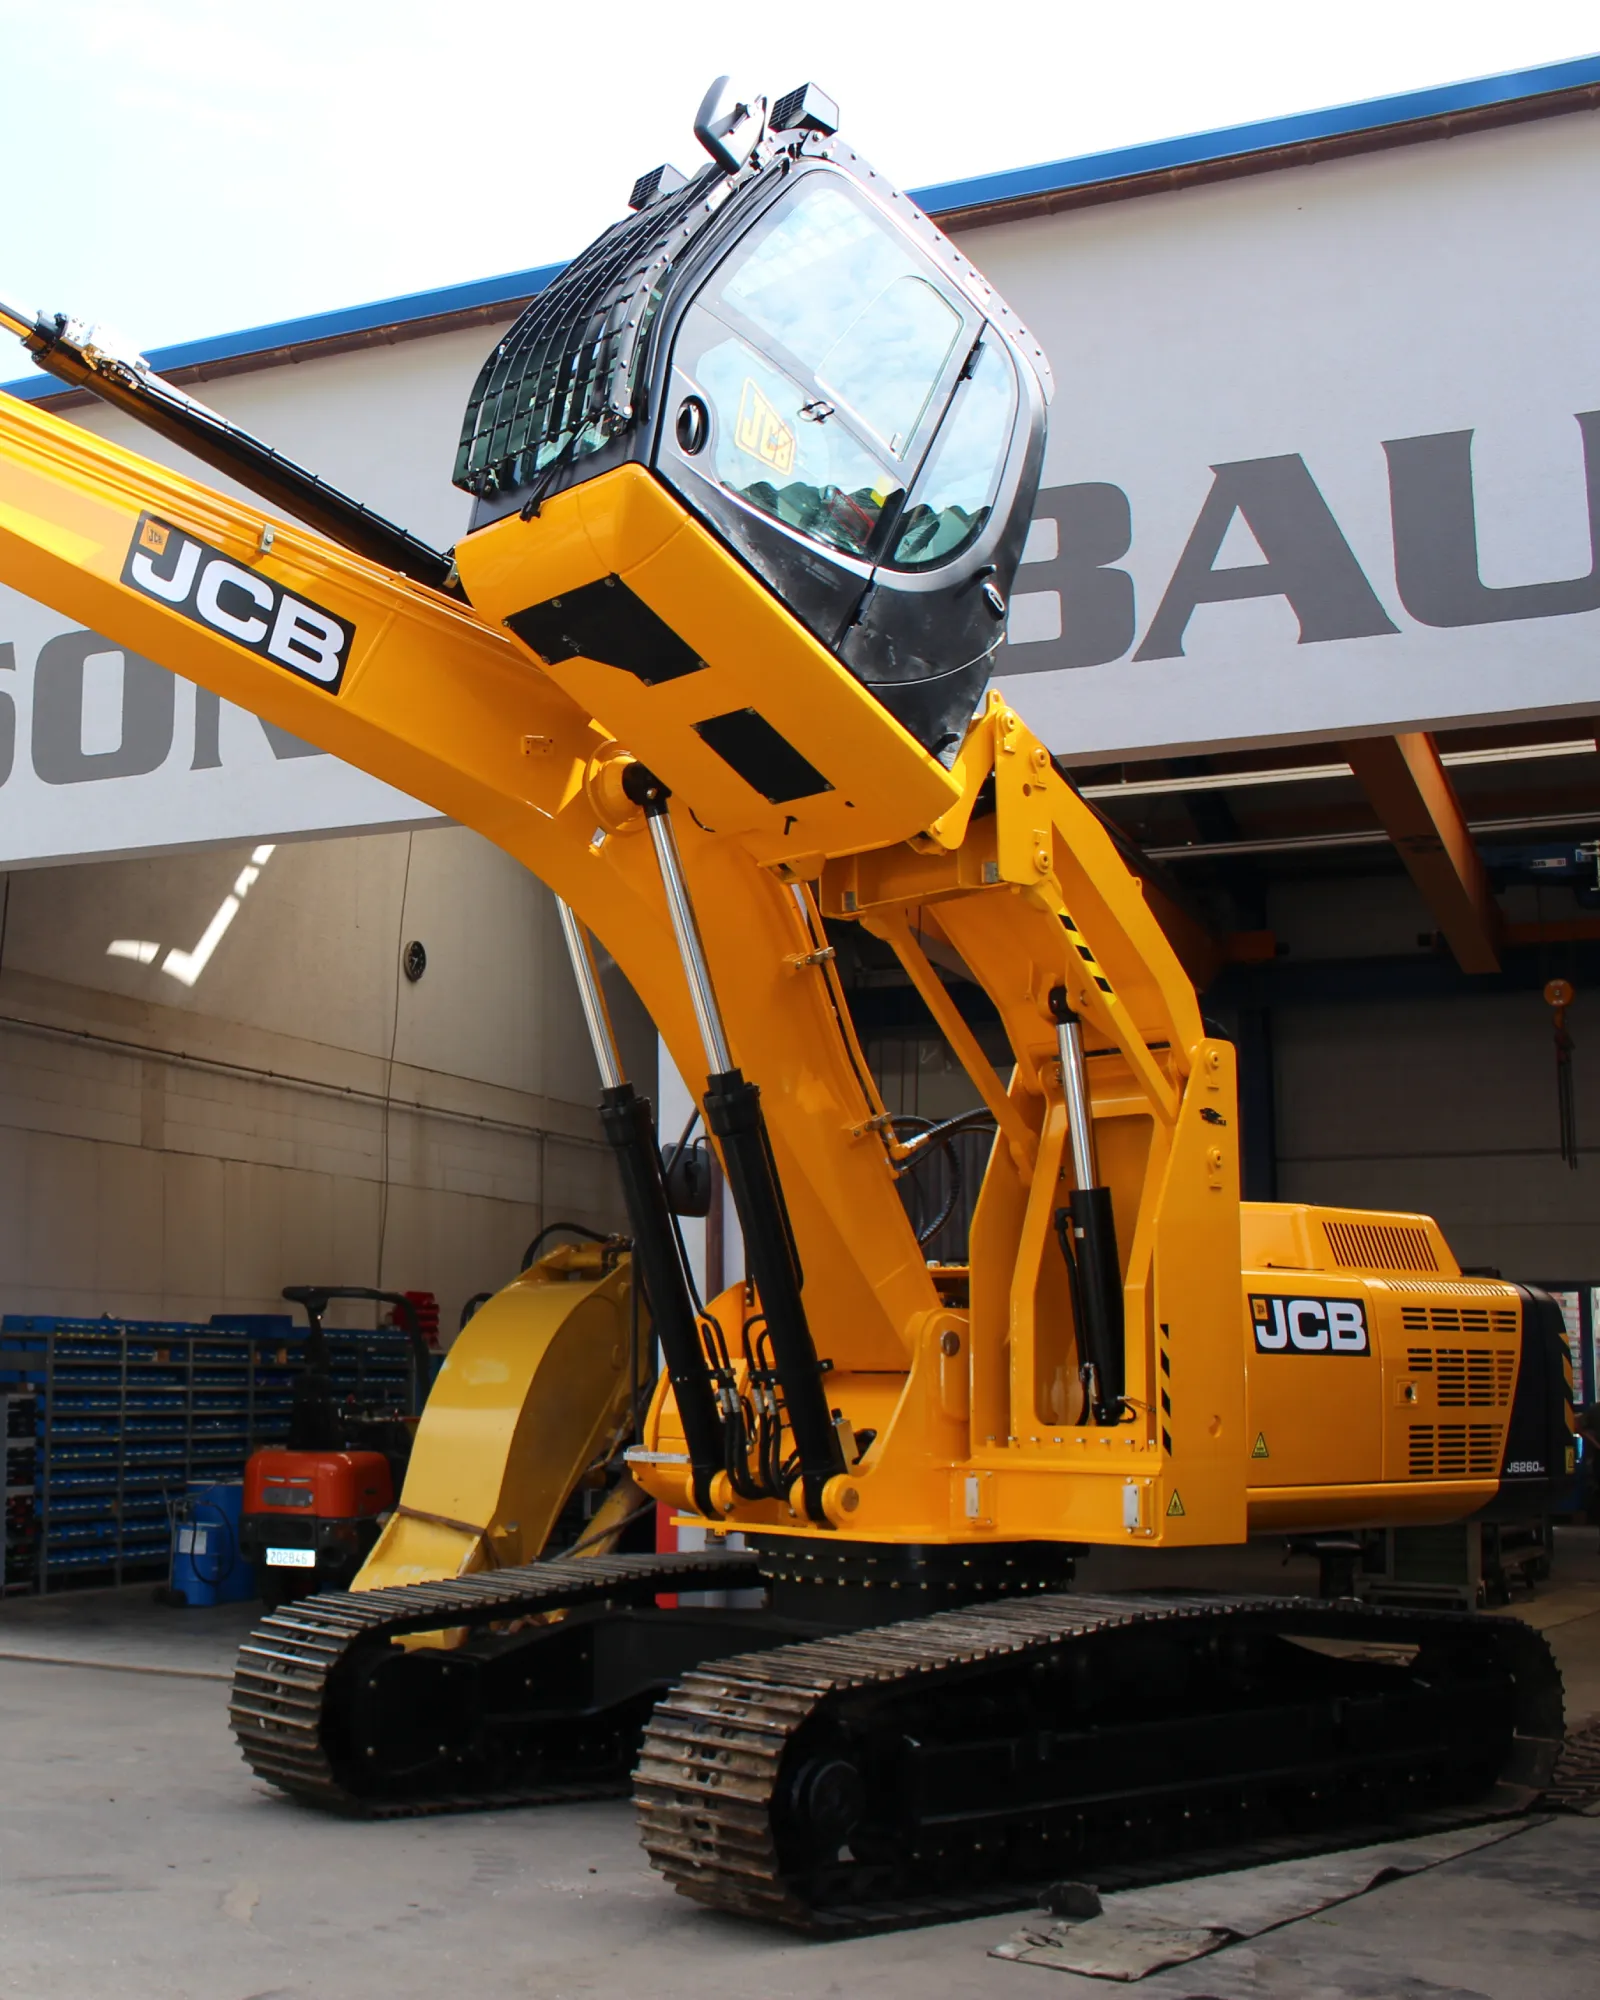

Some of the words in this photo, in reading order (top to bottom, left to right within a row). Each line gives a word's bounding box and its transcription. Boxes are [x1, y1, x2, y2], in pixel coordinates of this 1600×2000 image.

[740, 386, 792, 470] JCB
[132, 540, 345, 682] JCB
[1256, 1299, 1366, 1351] JCB
